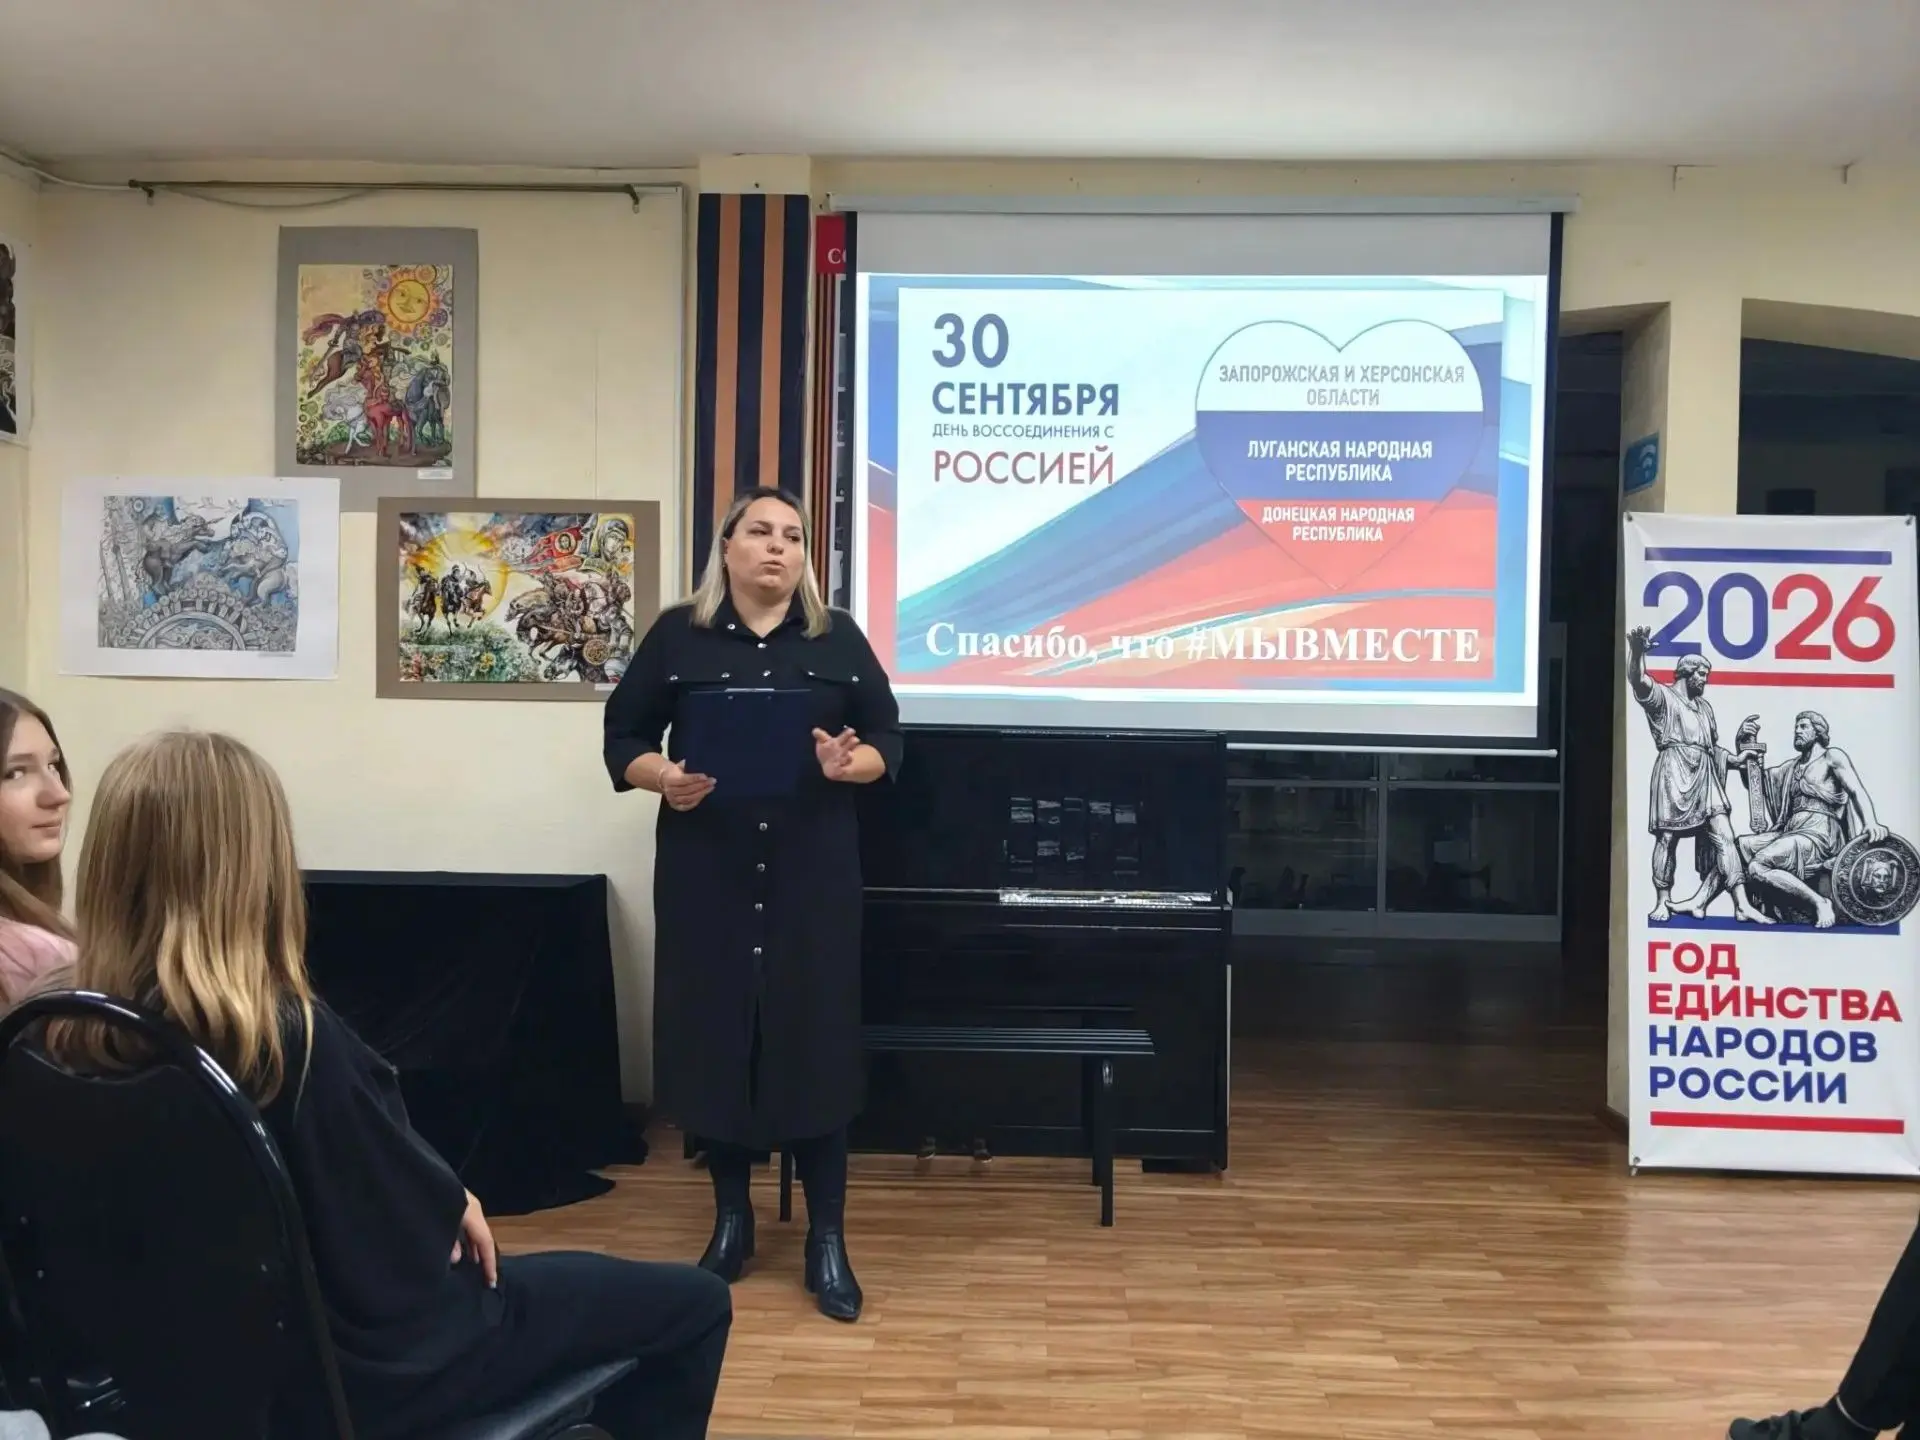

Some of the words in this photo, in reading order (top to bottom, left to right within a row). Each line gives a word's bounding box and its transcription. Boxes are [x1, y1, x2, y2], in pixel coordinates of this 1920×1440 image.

[932, 313, 1009, 368] 30
[1219, 365, 1339, 383] ЗАПОРОЖСКАЯ
[1344, 365, 1355, 383] И
[1360, 365, 1465, 383] ХЕРСОНСКАЯ
[932, 381, 1119, 416] СЕНТЯБРЯ
[1306, 388, 1380, 406] ОБЛАСТИ
[932, 423, 968, 438] ДЕНЬ
[972, 424, 1100, 439] ВОССОЕДИНЕНИЯ
[1104, 425, 1115, 439] С
[934, 445, 1114, 484] РОССИЕЙ
[1247, 440, 1341, 459] ЛУГАНСКАЯ
[1345, 441, 1433, 461] НАРОДНАЯ
[1285, 463, 1393, 481] РЕСПУБЛИКА
[1261, 506, 1337, 525] ДОНЕЦКАЯ
[1341, 507, 1415, 524] НАРОДНАЯ
[1292, 526, 1384, 541] РЕСПУБЛИКА
[1643, 570, 1896, 663] 2026
[925, 622, 1100, 665] Спасибо,
[1110, 634, 1175, 660] что
[1186, 627, 1480, 663] #МЫВМЕСТЕ
[1647, 941, 1740, 980] ГОД
[1648, 983, 1903, 1022] ЕДИНСТВА
[1649, 1025, 1878, 1066] НАРОДОВ
[1649, 1066, 1847, 1104] РОССИИ
